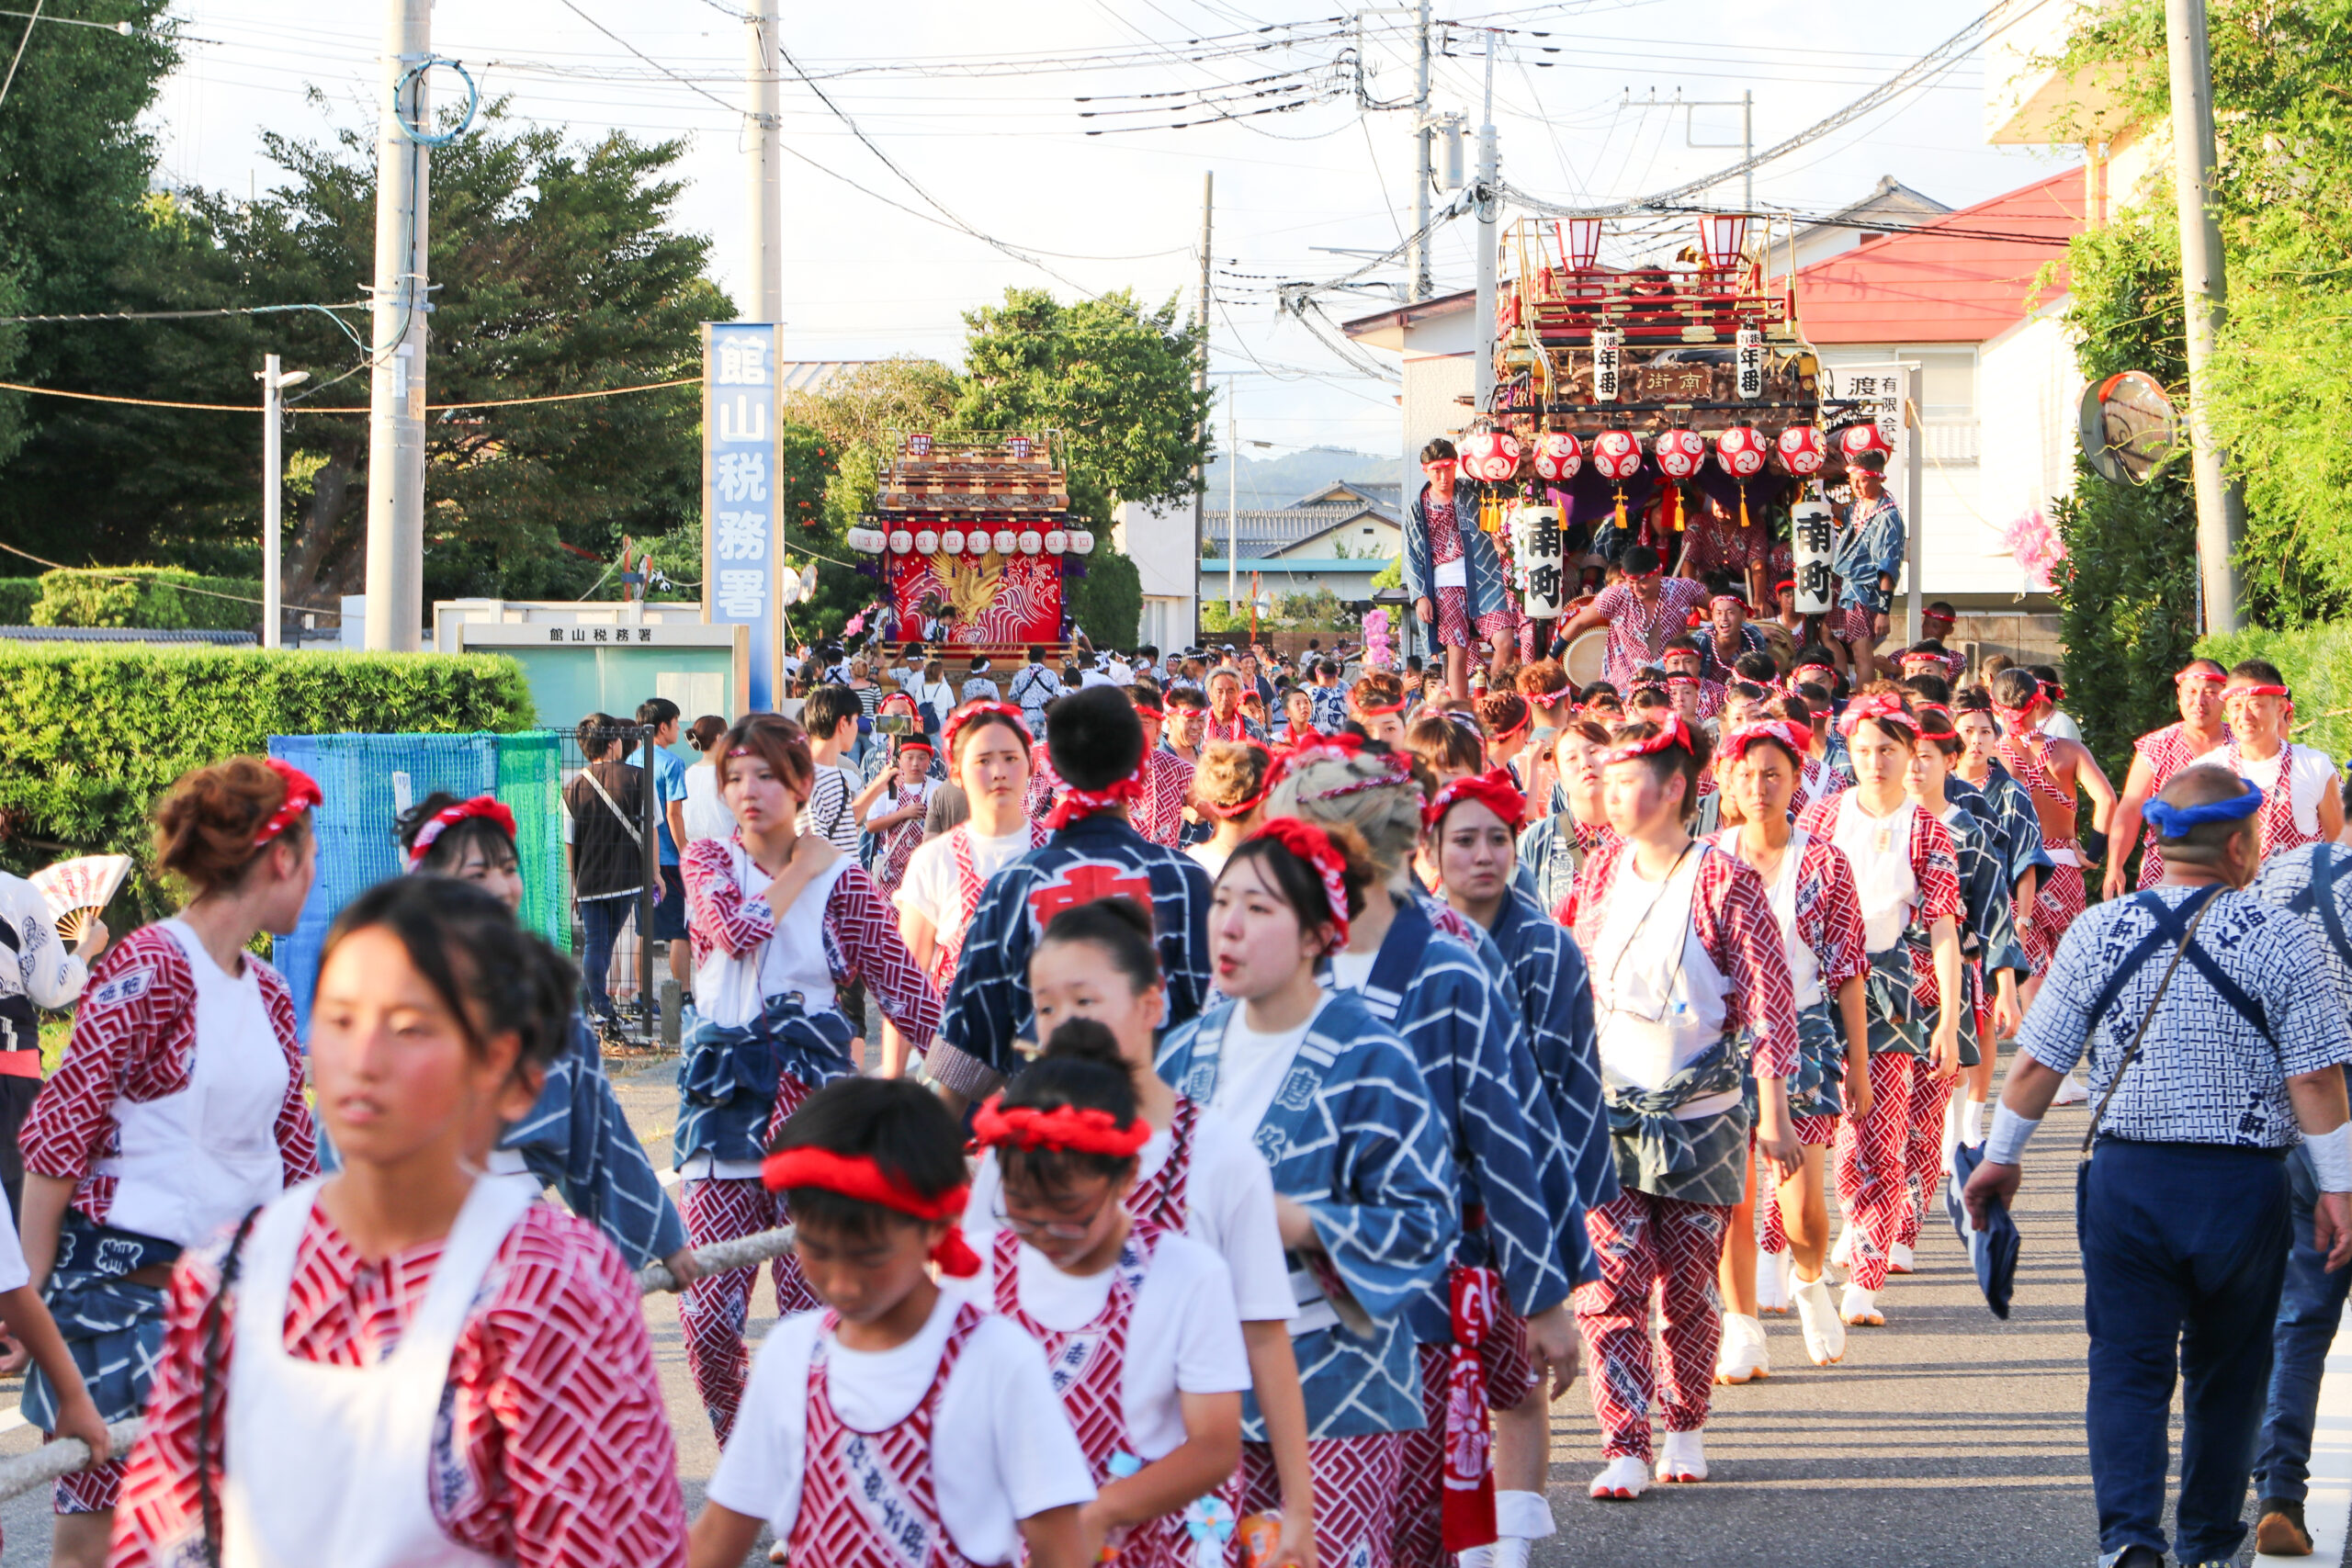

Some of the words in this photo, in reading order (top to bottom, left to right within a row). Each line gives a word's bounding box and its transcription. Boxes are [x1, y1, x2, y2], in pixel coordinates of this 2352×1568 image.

[1598, 349, 1617, 394] 年番
[1740, 347, 1760, 393] 年番
[718, 336, 766, 618] 館山税務署
[1528, 515, 1562, 609] 南町
[1796, 512, 1832, 605] 南町
[549, 627, 652, 643] 館山税務署
